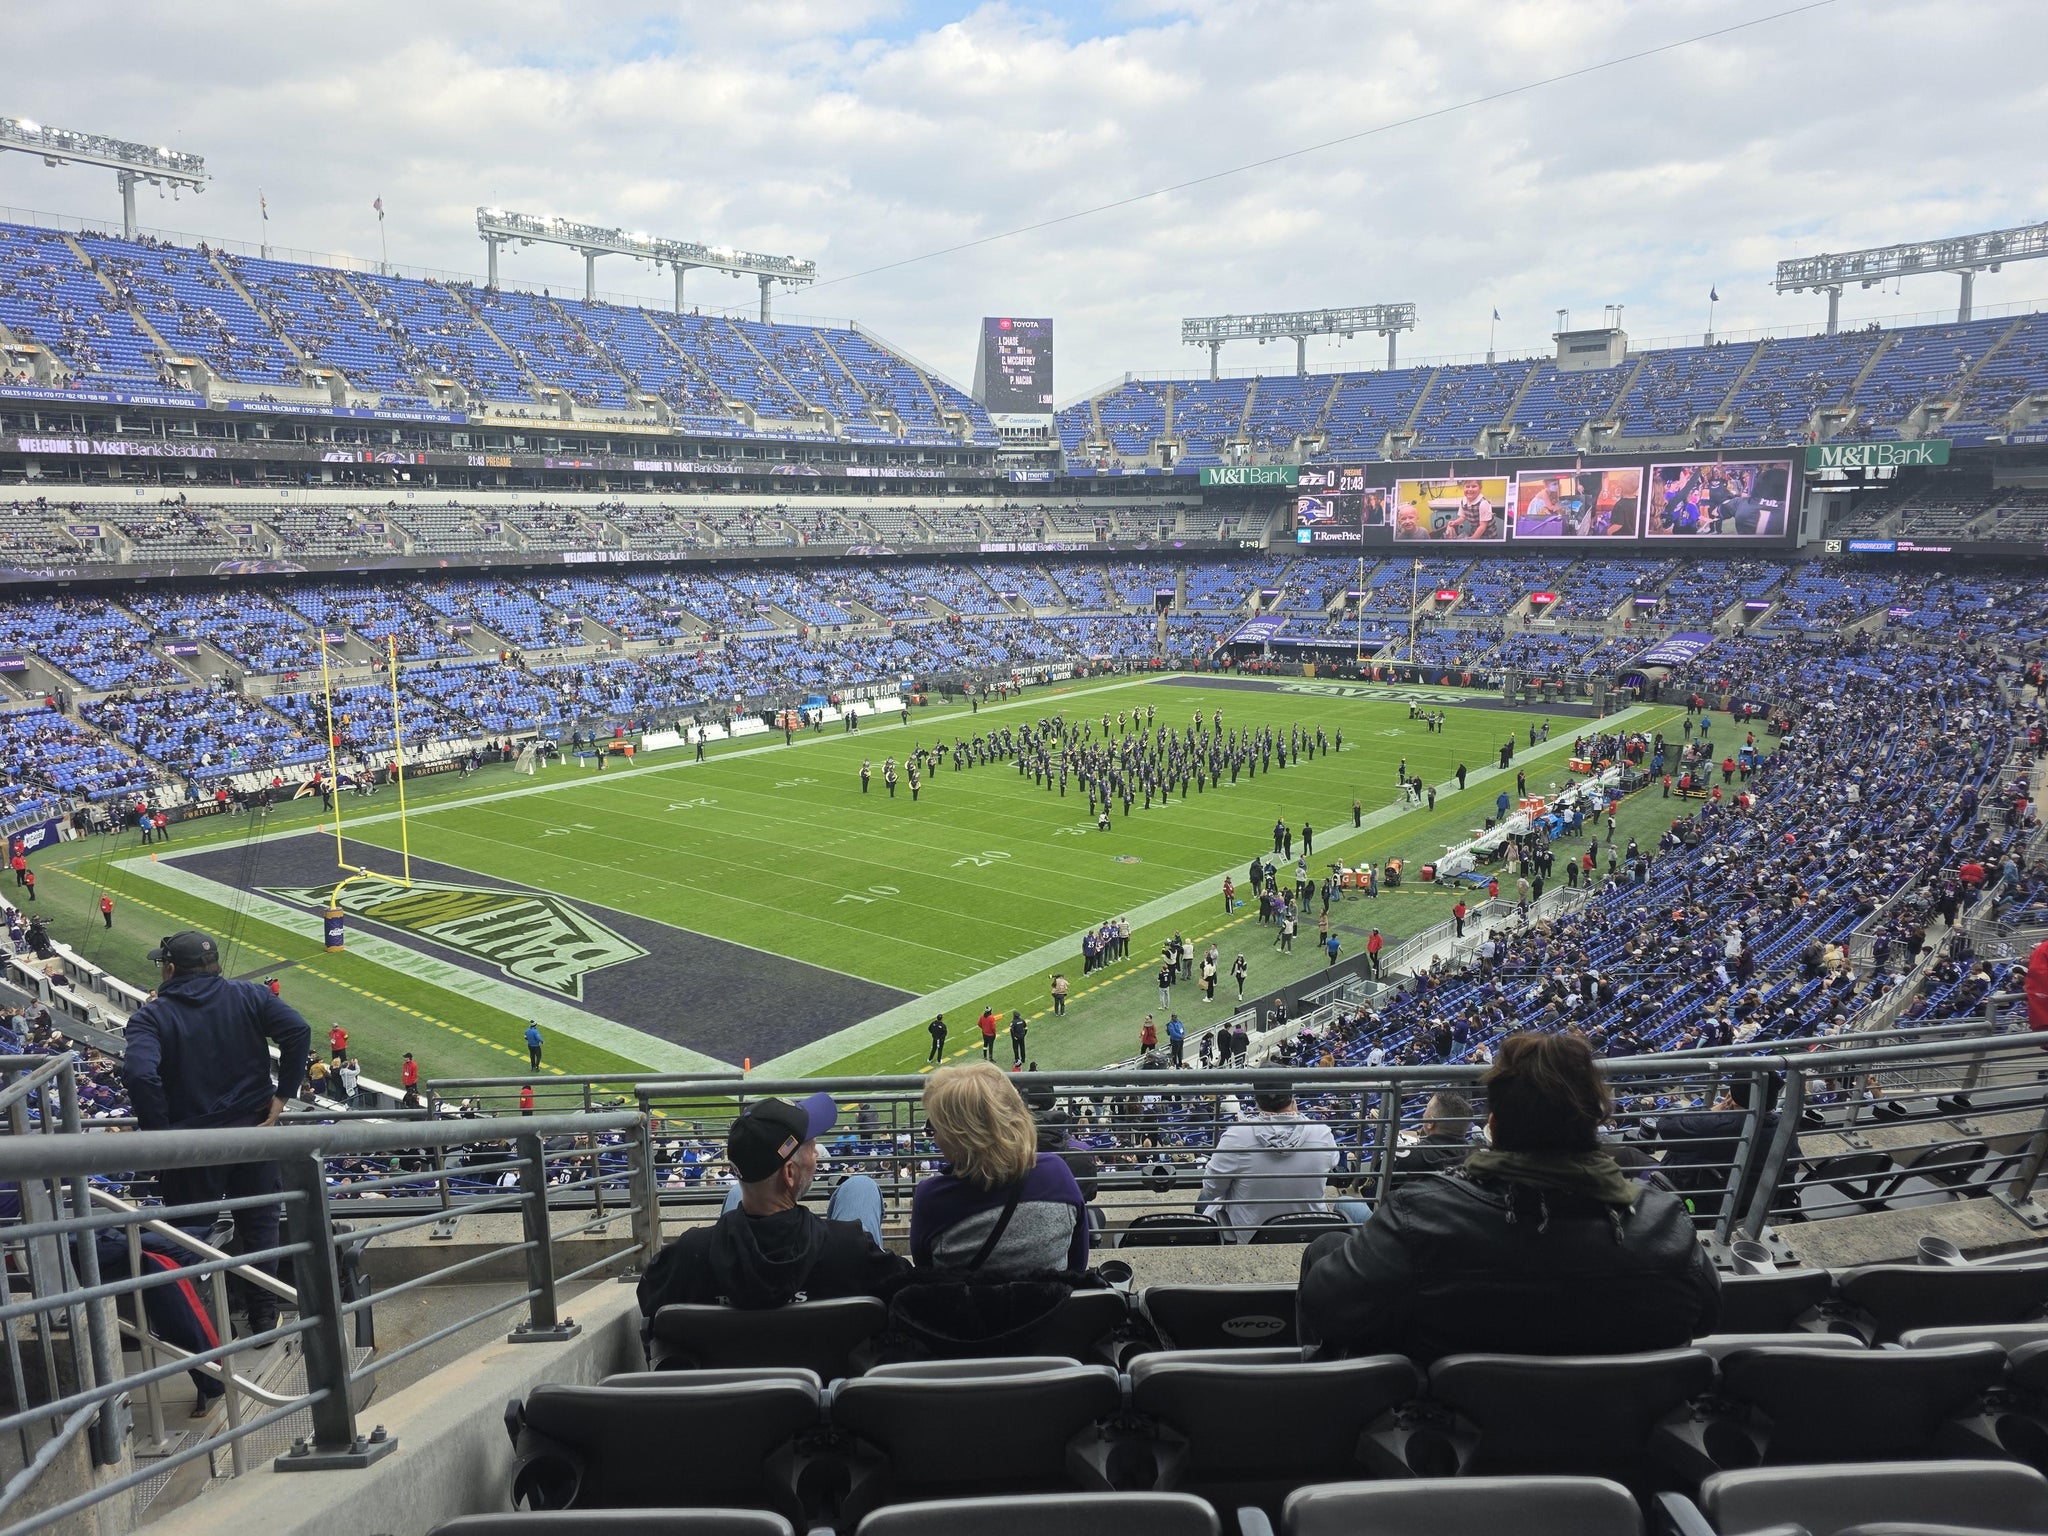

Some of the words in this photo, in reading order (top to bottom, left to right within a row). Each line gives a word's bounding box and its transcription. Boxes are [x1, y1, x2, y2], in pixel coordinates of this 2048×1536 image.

[1003, 337, 1018, 345] CHASE
[1007, 357, 1035, 366] MCCAFFREY
[130, 393, 159, 404] ARTHUR
[160, 396, 167, 405] B.
[168, 397, 196, 407] MODELL
[243, 403, 271, 411] MICHAEL
[272, 404, 301, 413] McCRARY
[392, 412, 422, 420] BOULWARE
[423, 413, 451, 422] 1997-2005
[18, 439, 73, 453] WELCOME
[75, 440, 88, 454] TO
[93, 441, 129, 455] M&T
[130, 443, 163, 456] Bank
[164, 444, 216, 458] Stadium
[1820, 444, 1876, 466] M&T
[1878, 443, 1934, 465] Bank
[468, 455, 484, 466] 21:43
[485, 457, 512, 467] PREGAME
[633, 461, 663, 472] WELCOME
[664, 462, 672, 472] TO
[674, 462, 693, 472] M&T
[694, 463, 713, 473] Bank
[713, 464, 744, 474] Stadium
[846, 468, 870, 477] WELCOME
[871, 468, 879, 477] TO
[880, 469, 897, 478] M&T
[898, 469, 915, 478] Bank
[916, 469, 945, 478] Stadium
[1209, 468, 1249, 484] M&T
[1250, 467, 1288, 484] Bank
[1327, 470, 1334, 487] 0
[1340, 477, 1363, 491] 21:43
[1327, 501, 1333, 517] 0
[1314, 532, 1321, 540] T.
[1321, 532, 1342, 540] Rowe
[1342, 532, 1361, 540] Price
[980, 544, 1007, 553] WELCOME
[1008, 544, 1016, 552] TO
[1017, 543, 1037, 552] M&T
[1057, 543, 1088, 551] Stadium
[1827, 541, 1839, 551] 25
[1850, 542, 1893, 550] PROGRESSIVE
[563, 552, 597, 563] WELCOME
[598, 552, 607, 562] TO
[609, 551, 631, 562] M&T
[631, 550, 653, 561] Bank
[653, 549, 687, 561] Stadium
[1012, 667, 1031, 677] FIGHT!
[1052, 663, 1073, 673] FIGHT!
[1053, 672, 1071, 681] RAVENS
[833, 688, 856, 699] HME
[857, 687, 865, 698] OF
[866, 685, 880, 698] THE
[881, 682, 900, 697] FLOCK
[1283, 684, 1466, 703] RAVENS
[196, 798, 231, 809] RAVES
[957, 851, 1011, 867] 20
[1343, 876, 1349, 884] G
[842, 885, 900, 904] 10
[365, 946, 458, 981] TAKES
[560, 1173, 570, 1184] 89
[1228, 1320, 1281, 1328] WPOC
